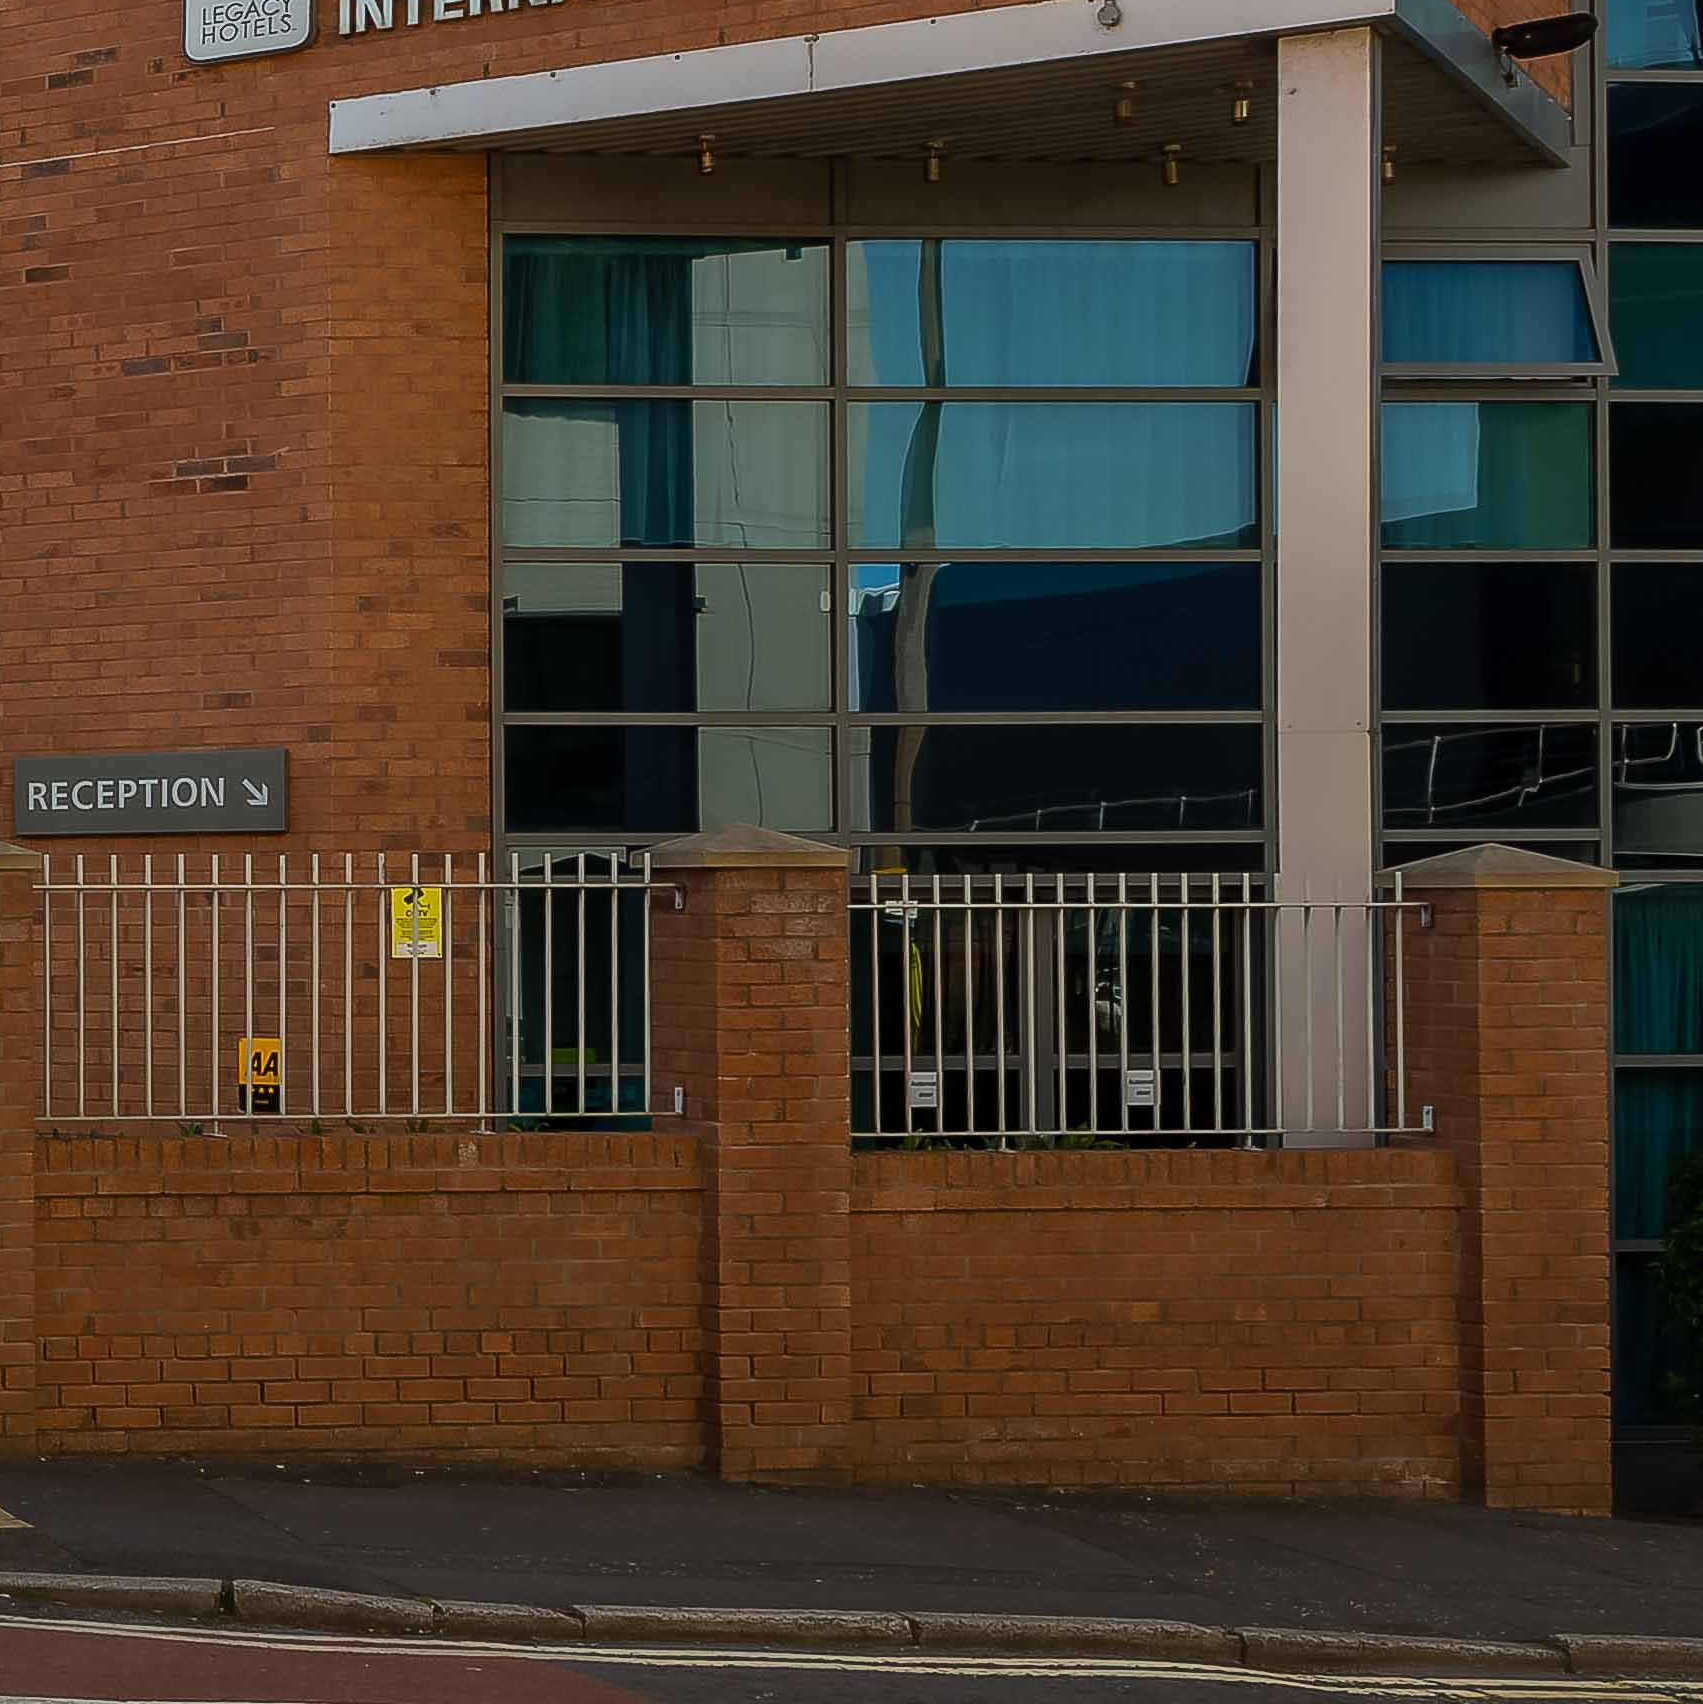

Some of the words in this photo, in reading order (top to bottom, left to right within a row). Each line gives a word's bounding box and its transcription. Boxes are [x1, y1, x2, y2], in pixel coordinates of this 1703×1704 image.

[202, 14, 292, 46] HOTELS
[28, 777, 225, 811] RECEPTION
[405, 909, 429, 918] CTV
[244, 1051, 279, 1077] AA
